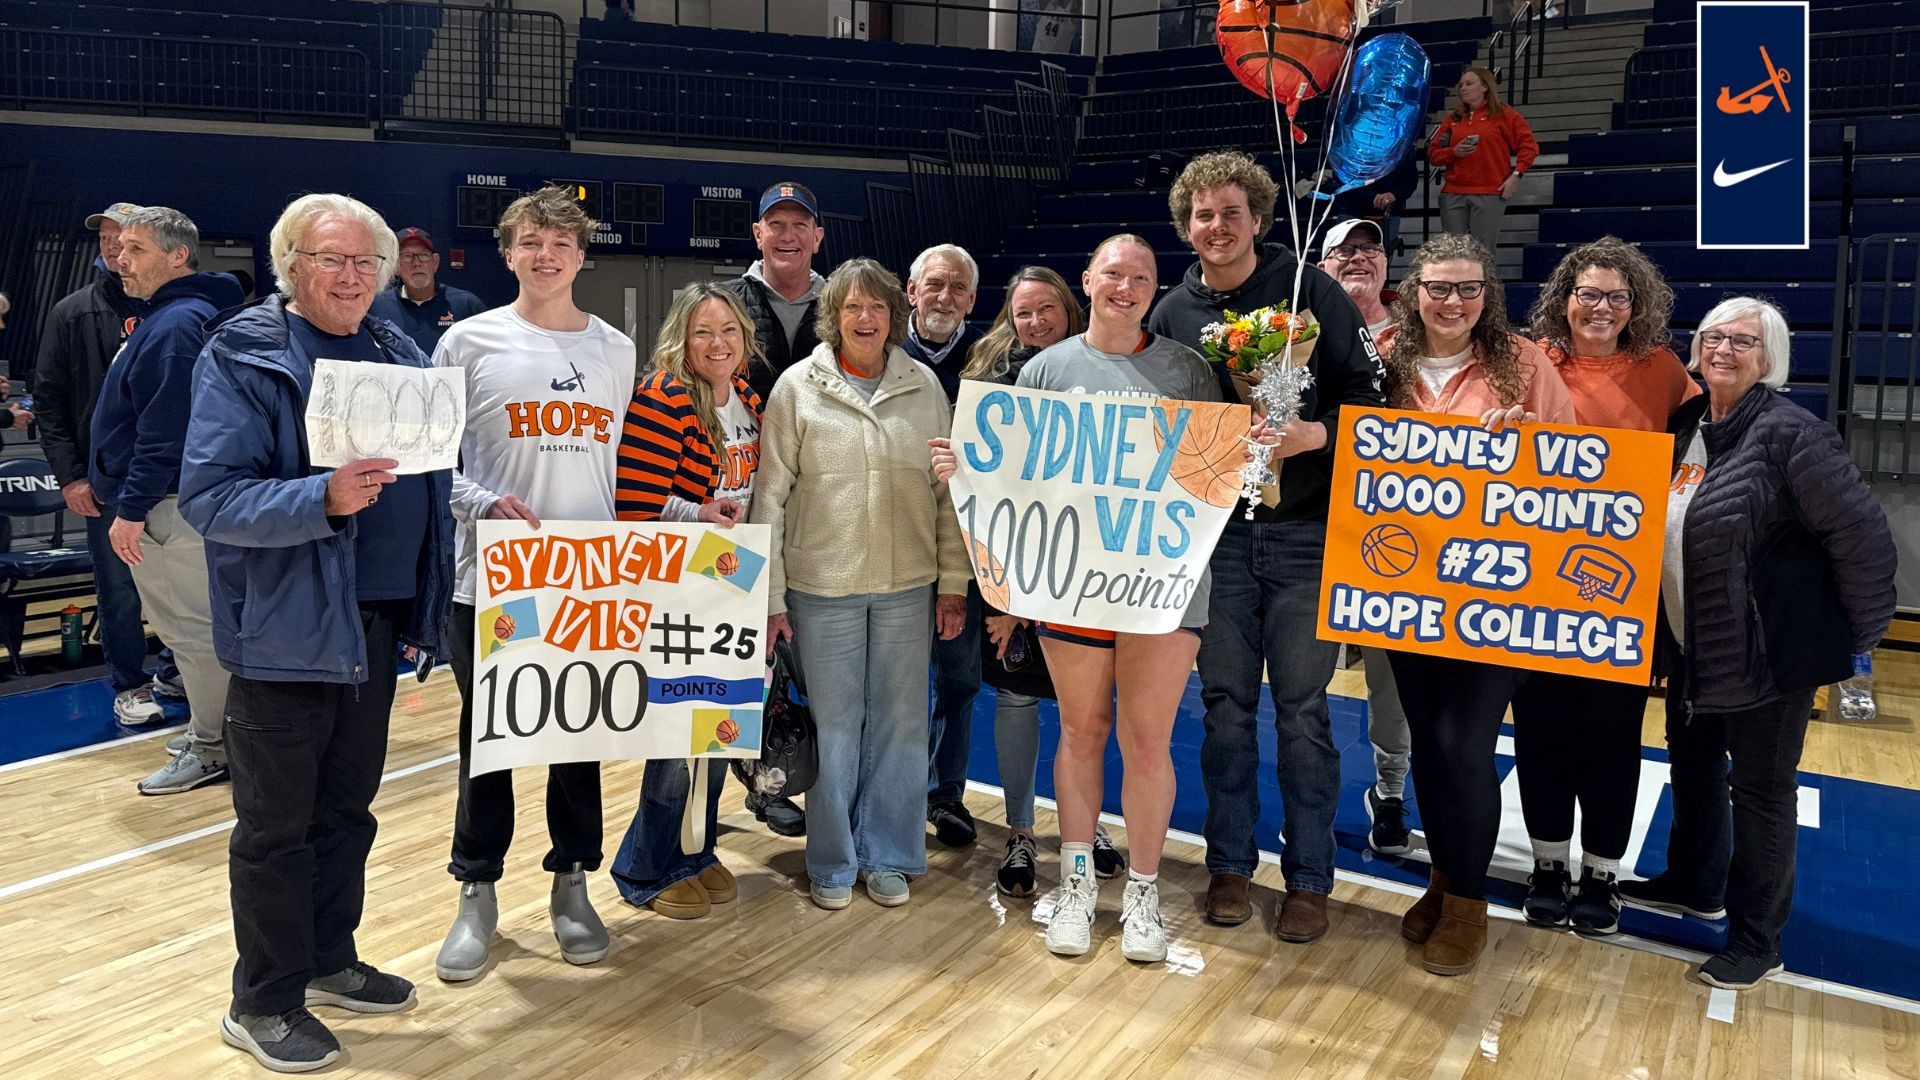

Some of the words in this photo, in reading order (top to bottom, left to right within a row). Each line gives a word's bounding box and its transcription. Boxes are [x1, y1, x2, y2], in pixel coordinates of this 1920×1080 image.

[467, 174, 507, 186] HOME
[701, 186, 742, 199] VISITOR
[590, 233, 622, 244] ERIOD
[598, 222, 612, 231] OSS
[690, 237, 720, 248] BONUS
[505, 400, 614, 444] HOPE
[964, 390, 1192, 492] SYDNEY
[1354, 417, 1520, 474] SYDNEY
[1535, 432, 1608, 480] VIS
[1095, 496, 1195, 558] VIS
[1355, 470, 1464, 515] 1,000
[1482, 482, 1643, 538] POINTS
[485, 532, 685, 593] SYDNEY
[959, 495, 1079, 599] 1,000
[1073, 564, 1194, 617] points
[1438, 539, 1530, 589] #25
[550, 598, 649, 650] VIS
[1331, 585, 1445, 640] HOPE
[1457, 601, 1642, 664] COLLEGE
[477, 660, 648, 743] 1000
[661, 682, 727, 697] POINTS
